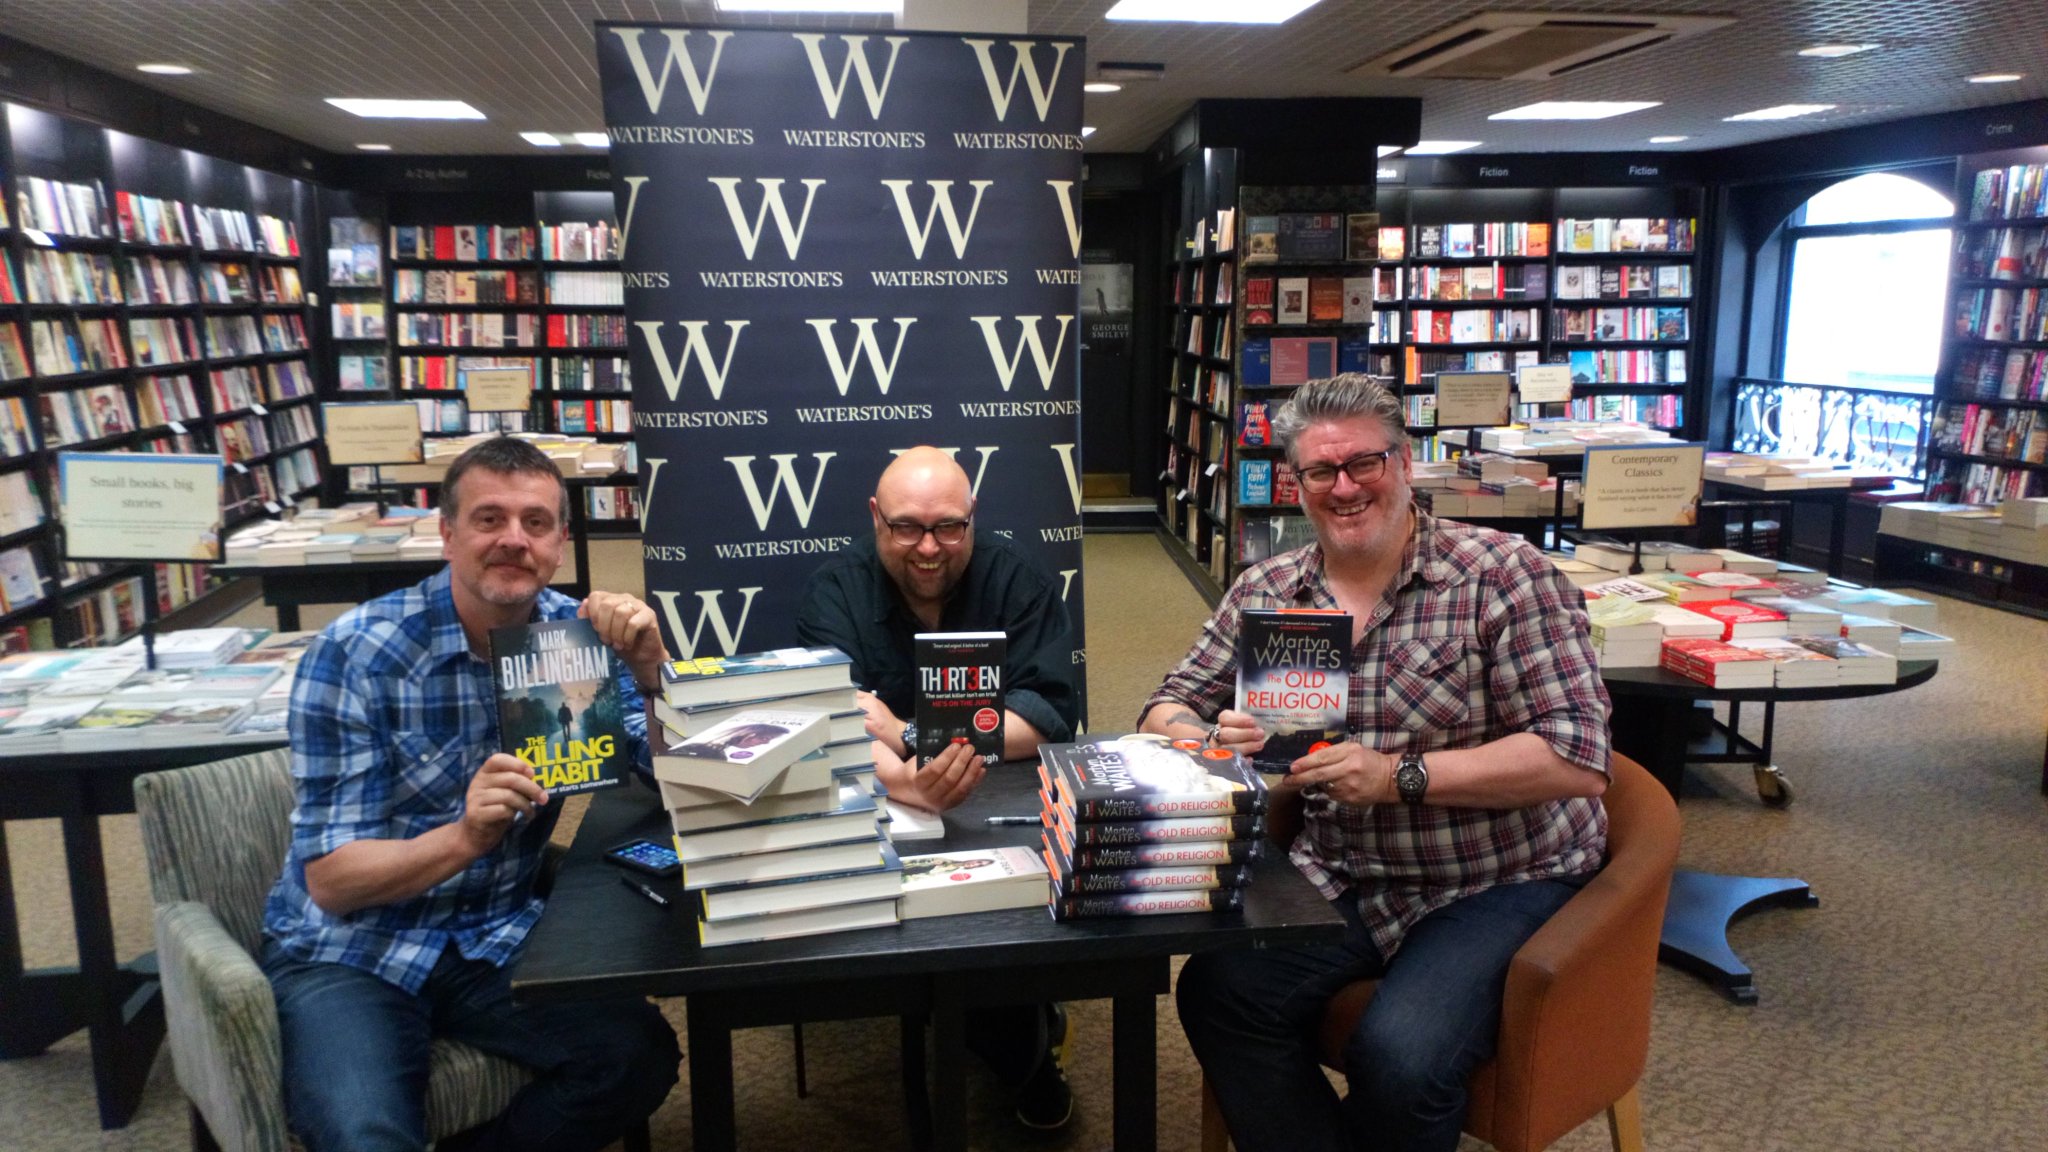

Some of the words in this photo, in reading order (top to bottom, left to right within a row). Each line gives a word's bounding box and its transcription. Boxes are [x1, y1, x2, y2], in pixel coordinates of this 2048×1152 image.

[611, 28, 734, 115] W
[792, 33, 910, 120] W
[962, 37, 1075, 122] W
[607, 127, 754, 146] WATERSTONE'S
[1986, 124, 2014, 136] Crime
[783, 130, 926, 148] WATERSTONE'S
[1480, 166, 1509, 177] Fiction
[1629, 165, 1658, 176] Fiction
[708, 177, 827, 260] W
[881, 179, 994, 260] W
[700, 271, 844, 288] WATERSTONE'S
[871, 270, 1009, 287] WATERSTONE'S
[1092, 323, 1129, 331] GEORGE
[633, 319, 750, 401] W
[805, 317, 918, 396] W
[970, 315, 1074, 391] W
[633, 410, 769, 428] WATERSTONE'S
[796, 404, 933, 423] WATERSTONE'S
[1611, 455, 1679, 466] Contemporary
[1624, 468, 1663, 478] Classics
[90, 476, 125, 488] Small
[174, 478, 194, 493] big
[724, 451, 837, 531] W
[121, 498, 163, 509] stories
[652, 586, 763, 661] W
[538, 629, 567, 650] MARK
[1267, 632, 1330, 650] Martyn
[1254, 648, 1341, 669] WAITES
[501, 645, 610, 691] BILLINGHAM
[919, 665, 1000, 692] TH1RT3EN
[1267, 673, 1282, 684] The
[1285, 671, 1326, 689] OLD
[1247, 691, 1340, 710] RELIGION
[525, 735, 547, 747] THE
[515, 735, 615, 768] KILLING
[533, 758, 603, 789] HABIT
[1087, 759, 1105, 785] Martyn
[1100, 753, 1136, 792] WAITES
[559, 783, 579, 793] starts
[580, 777, 619, 789] somewhere
[1098, 805, 1141, 817] WAITES
[1105, 799, 1135, 808] Martyn
[1157, 802, 1180, 812] OLD
[1181, 800, 1229, 811] RELIGION
[1098, 831, 1141, 843] WAITES
[1105, 826, 1134, 835] Martyn
[1157, 828, 1179, 838] OLD
[1181, 825, 1228, 837] RELIGION
[1095, 855, 1137, 866] WAITES
[1101, 849, 1131, 858] Martyn
[1153, 852, 1174, 862] OLD
[1177, 849, 1224, 861] RELIGION
[1084, 880, 1125, 891] WAITES
[1090, 874, 1120, 883] Martyn
[1142, 876, 1163, 887] OLD
[1165, 873, 1213, 885] RELIGION
[1135, 901, 1156, 911] OLD
[1158, 899, 1205, 910] RELIGION
